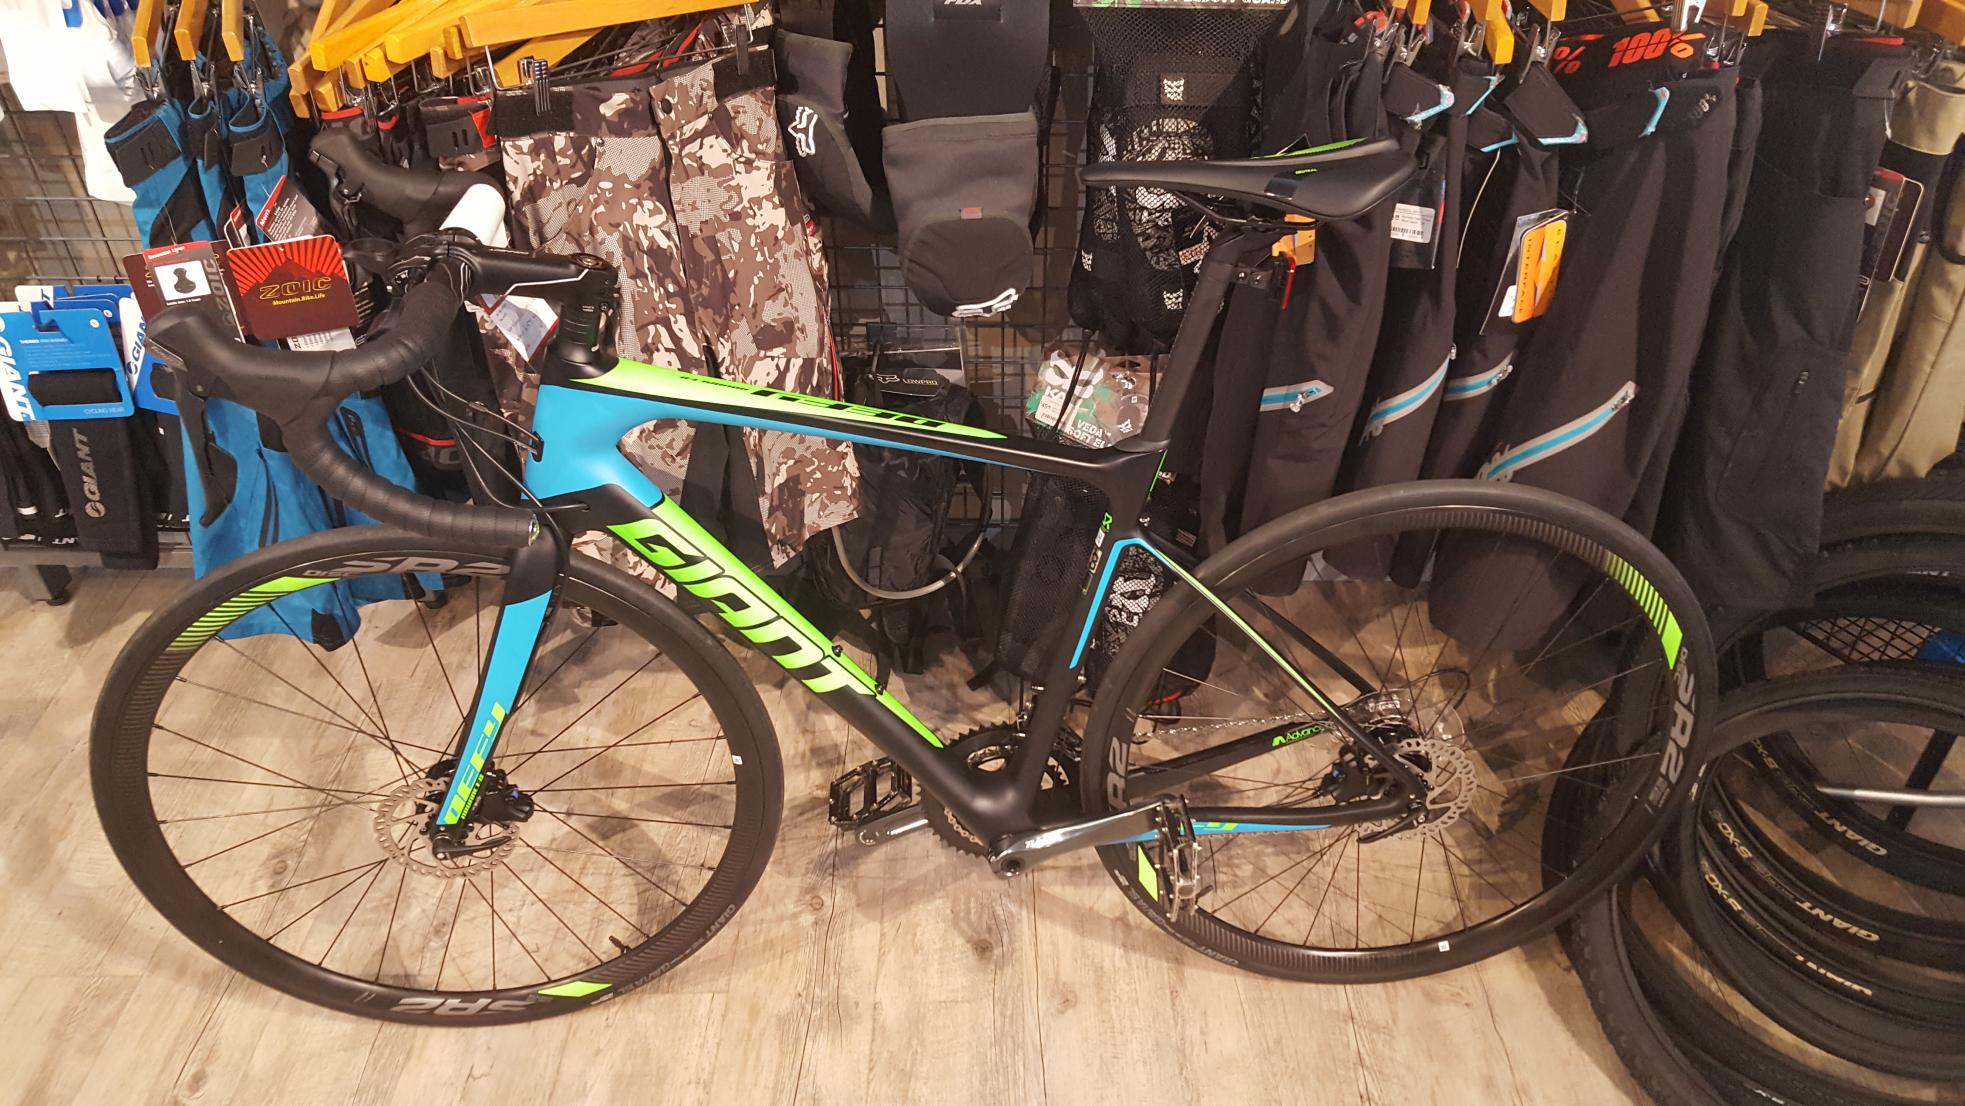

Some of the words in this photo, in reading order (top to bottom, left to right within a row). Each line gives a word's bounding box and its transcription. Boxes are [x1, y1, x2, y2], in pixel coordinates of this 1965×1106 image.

[1608, 28, 1706, 68] 100%
[259, 276, 332, 300] ZOIC
[131, 315, 147, 363] GIAN
[72, 427, 100, 501] GIANT
[606, 518, 877, 696] GIANT
[443, 701, 506, 825] DEFY
[1107, 736, 1130, 809] R2
[1814, 810, 1888, 856] GIANT
[1795, 899, 1880, 943] GIANT
